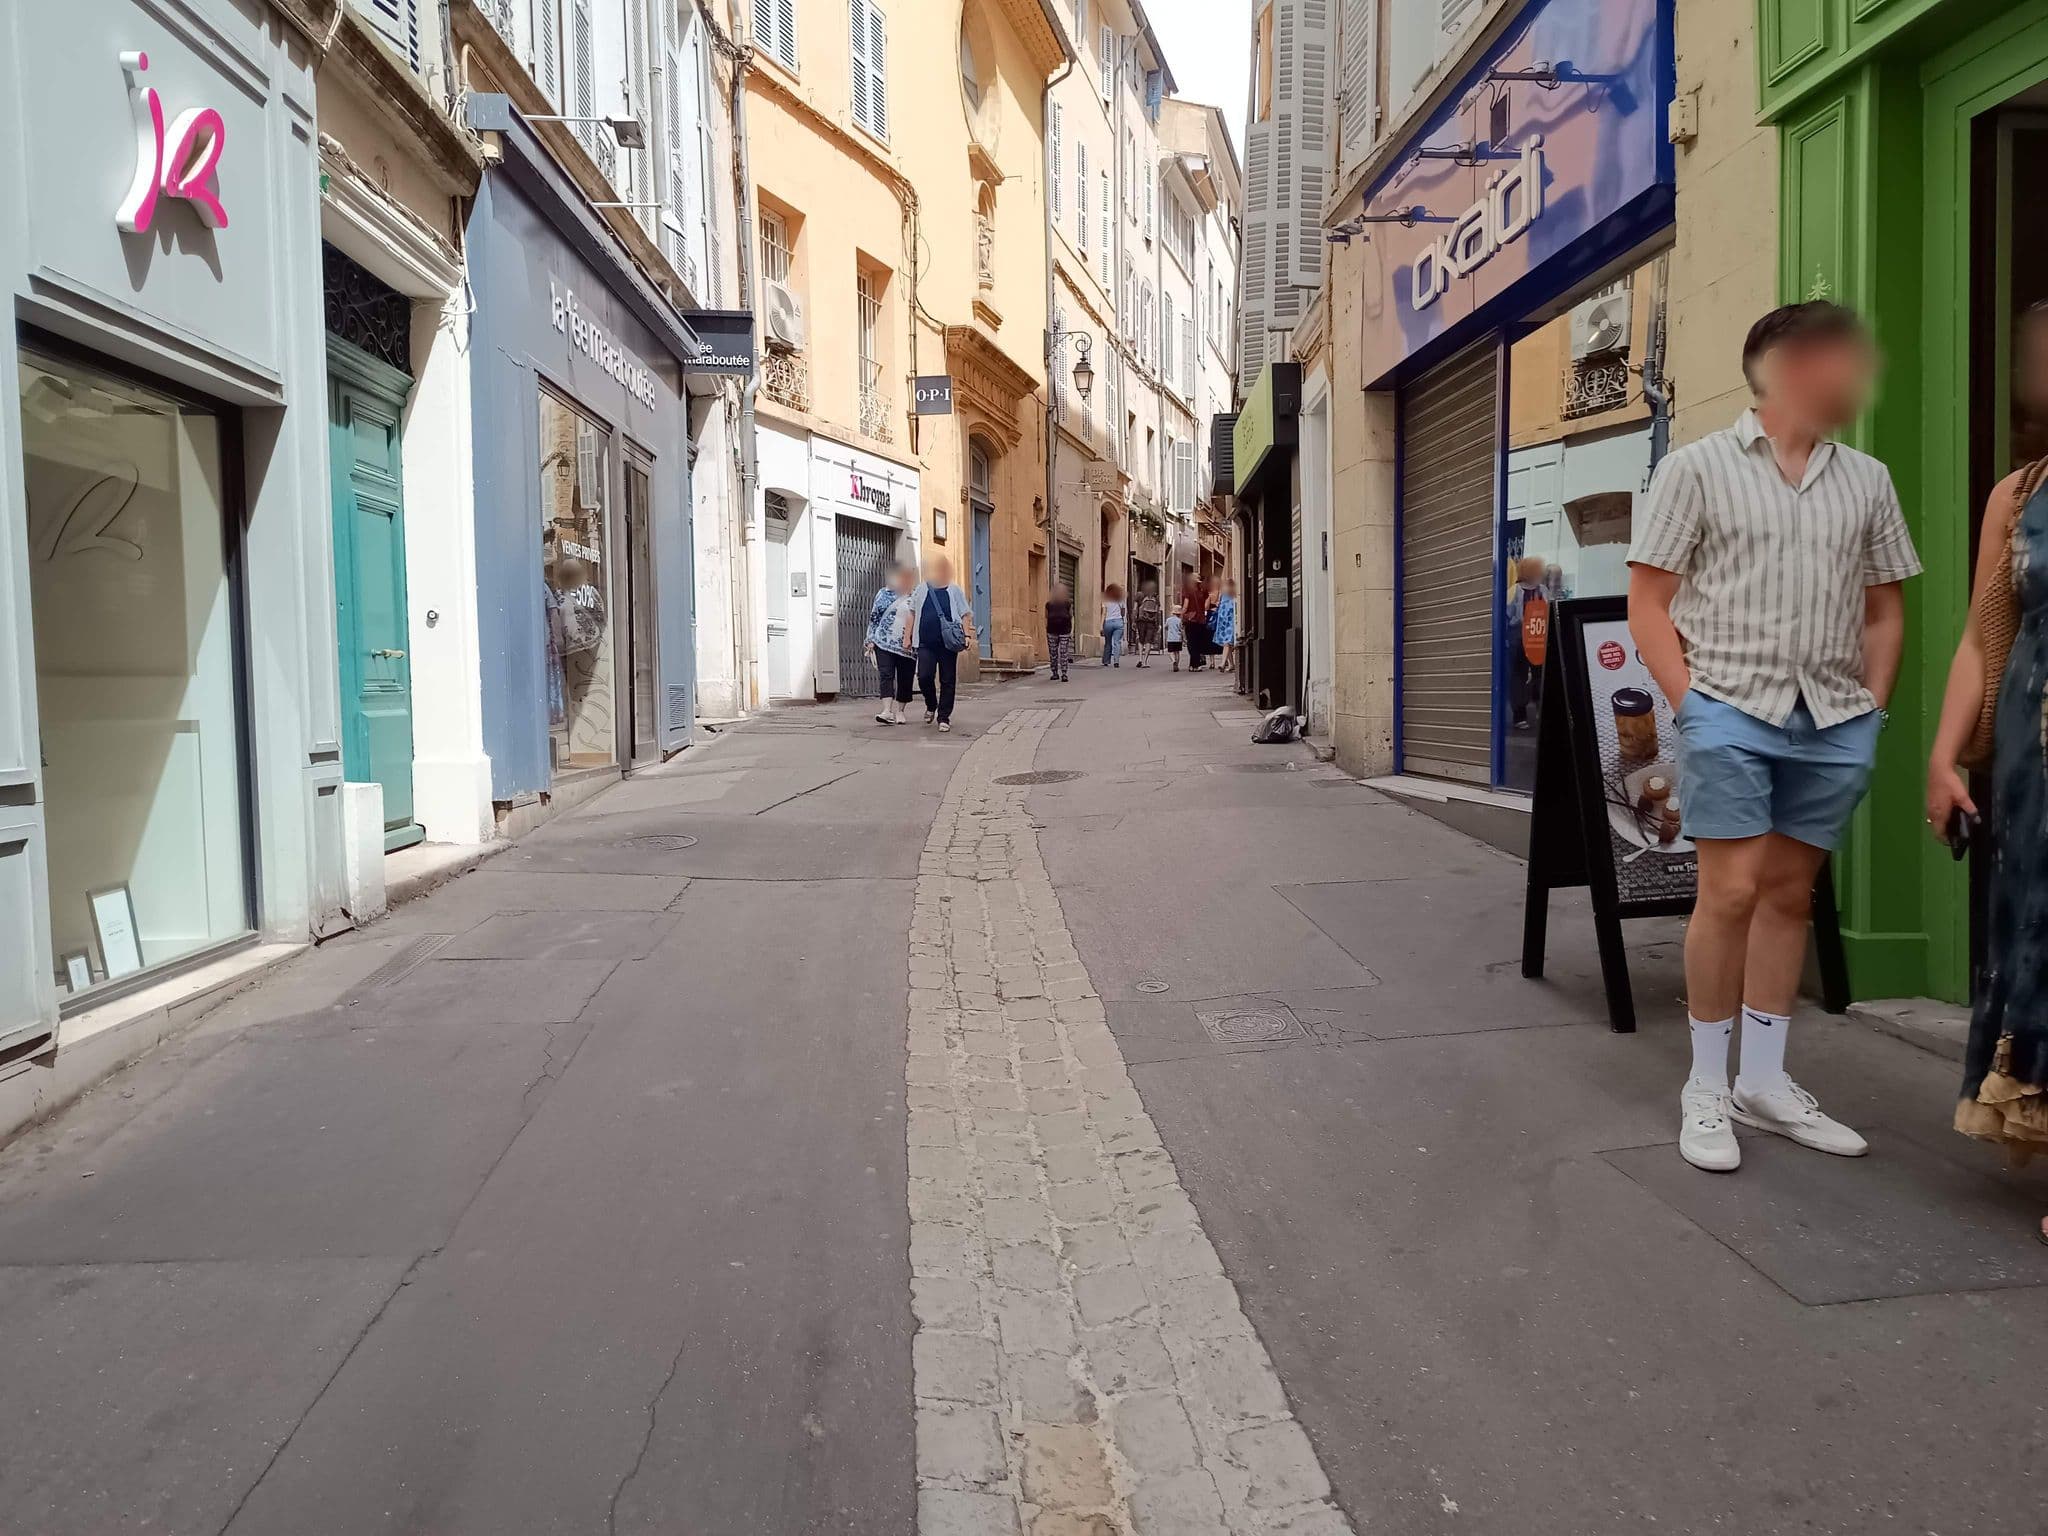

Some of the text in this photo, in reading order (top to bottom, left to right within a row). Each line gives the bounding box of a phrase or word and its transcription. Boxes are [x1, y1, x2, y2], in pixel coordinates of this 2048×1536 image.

[1412, 134, 1541, 311] okaïdi
[551, 281, 656, 410] la fée maraboutée
[850, 474, 890, 511] Khroma
